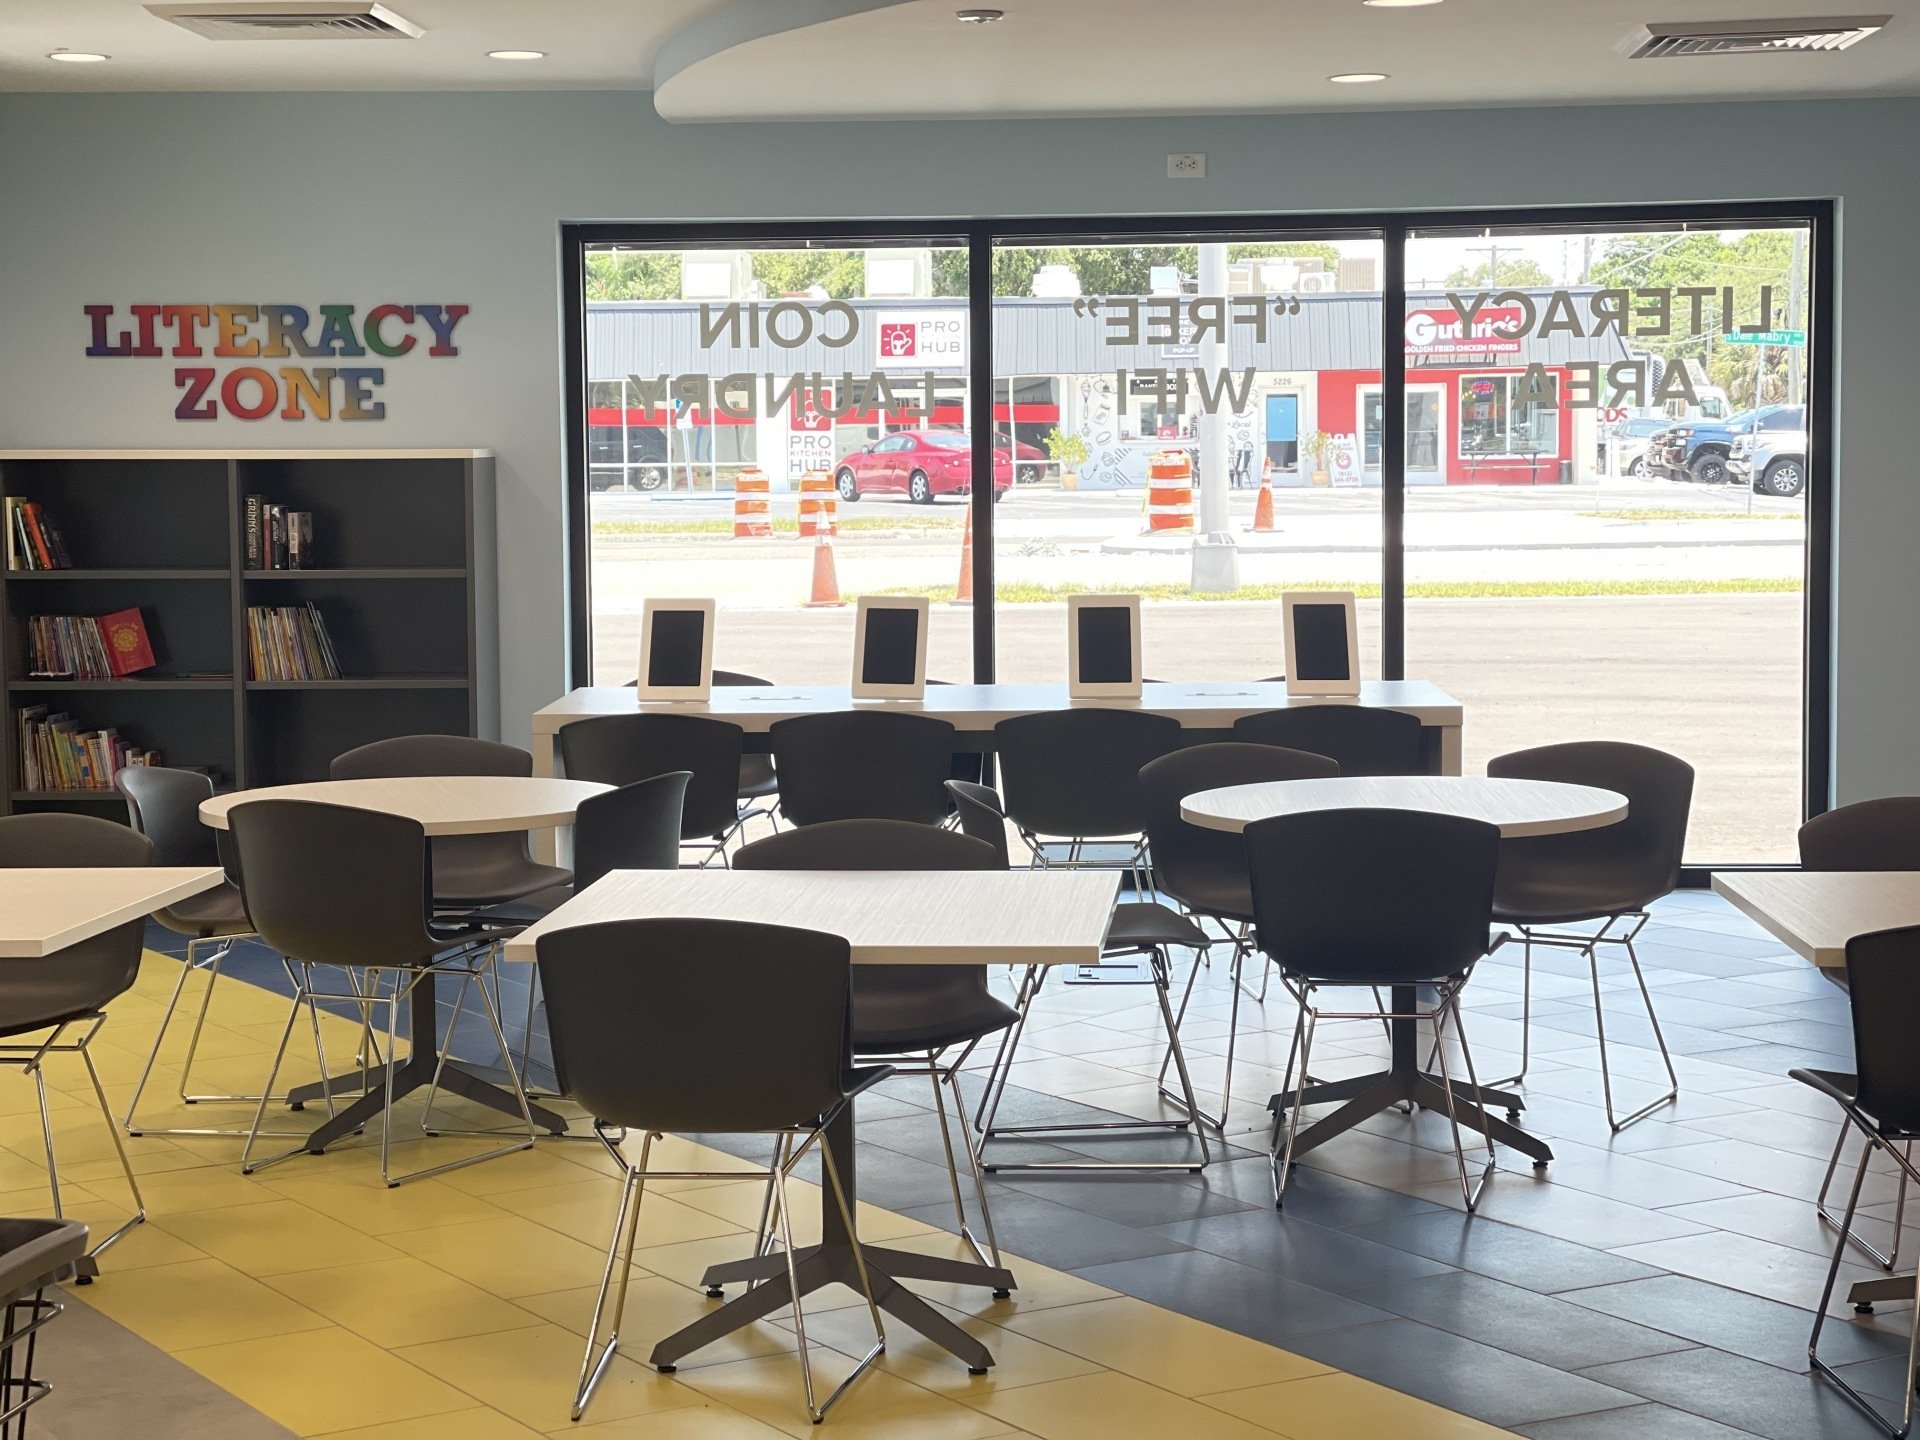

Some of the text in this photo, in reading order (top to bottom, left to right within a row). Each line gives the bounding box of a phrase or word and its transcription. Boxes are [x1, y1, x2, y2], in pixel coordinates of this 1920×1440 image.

[84, 304, 469, 357] LITERACY
[921, 321, 960, 333] PRO
[1758, 331, 1791, 345] Mabry
[921, 341, 960, 352] HUB
[1405, 345, 1434, 353] GOLDEN
[1456, 344, 1487, 352] CHICKEN
[174, 366, 385, 420] ZONE
[790, 435, 831, 449] PRO
[790, 459, 831, 472] HUB
